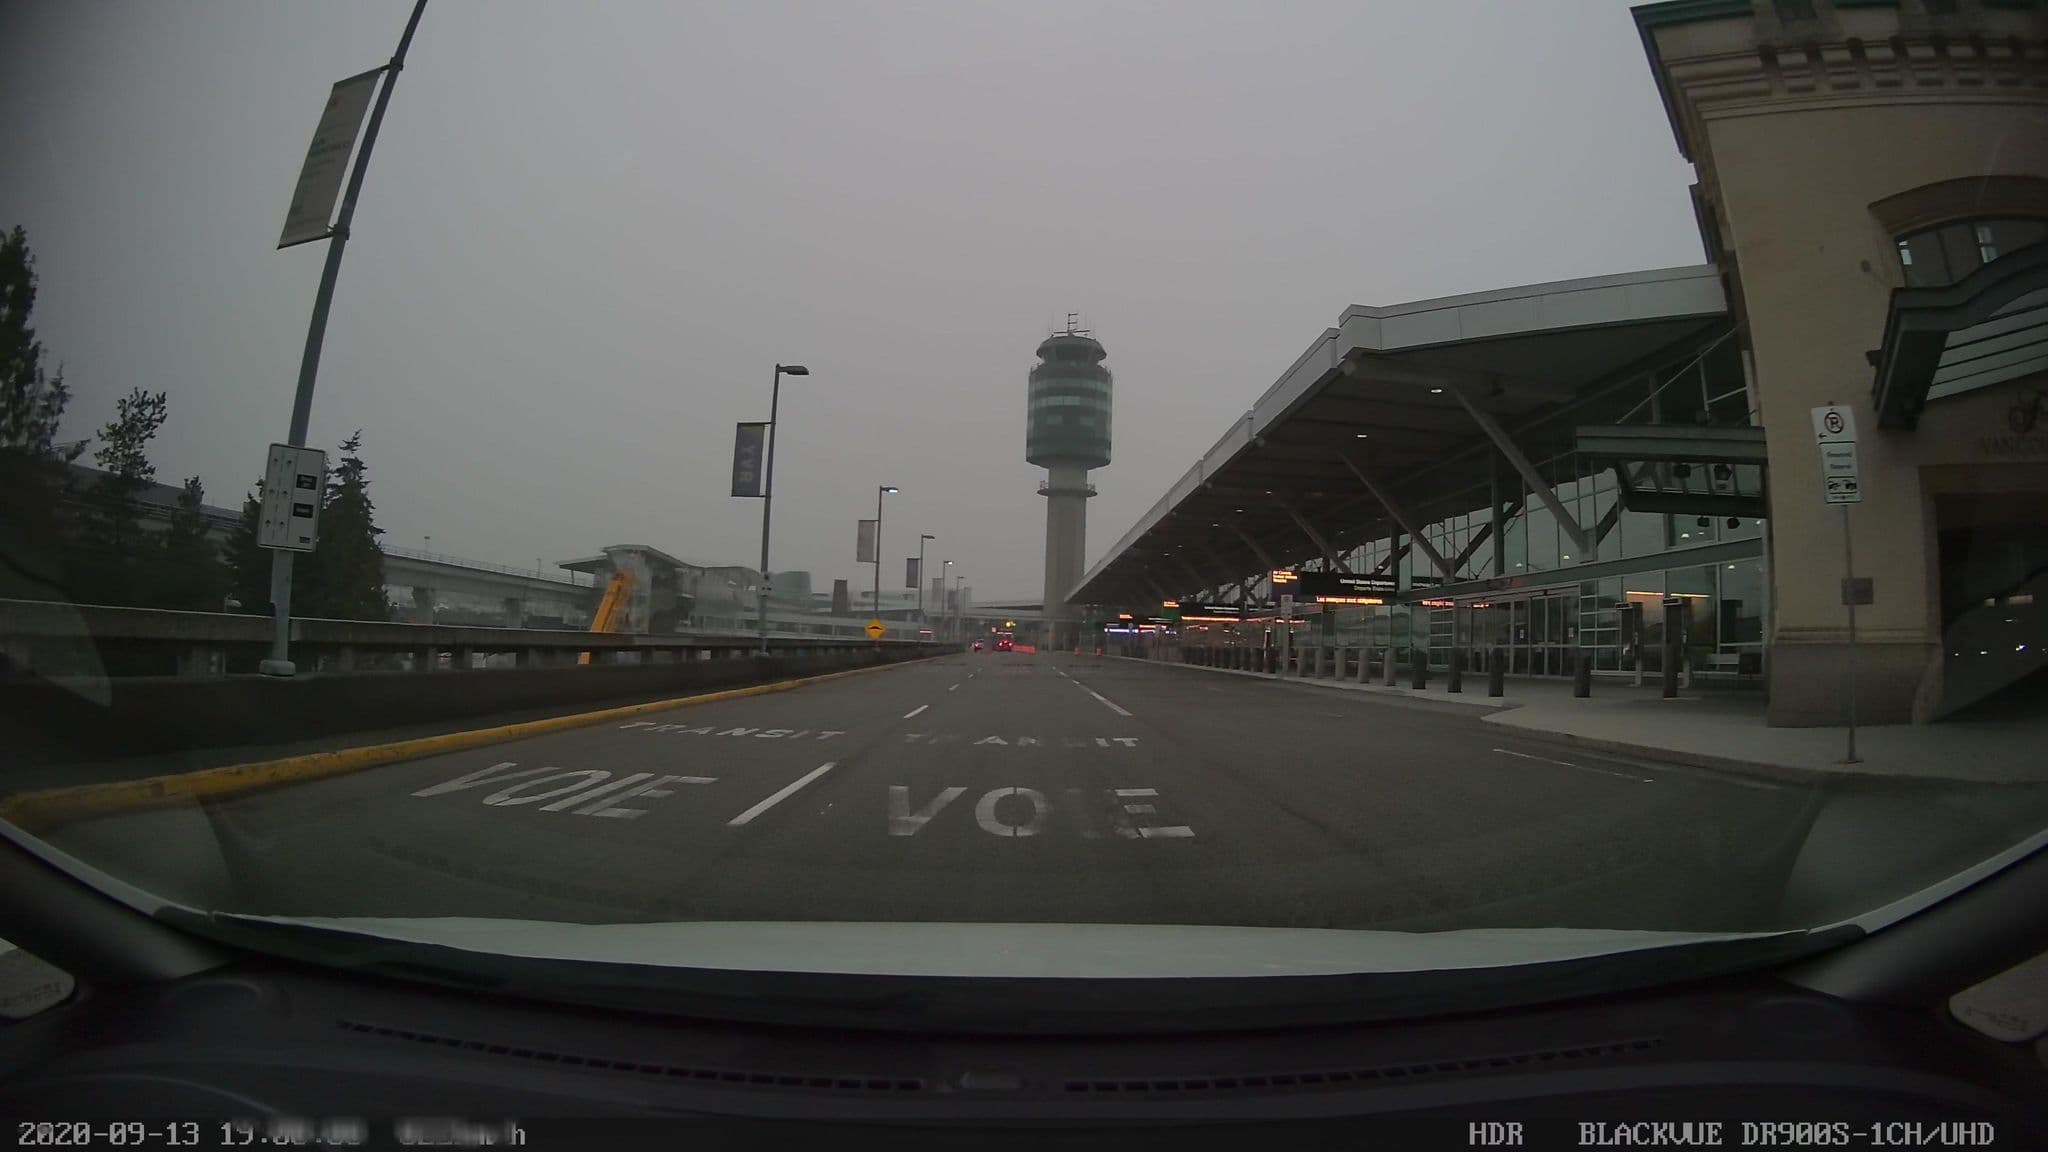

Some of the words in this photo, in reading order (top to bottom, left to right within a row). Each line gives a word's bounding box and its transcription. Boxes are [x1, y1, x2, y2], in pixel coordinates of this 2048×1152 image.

[619, 721, 846, 740] TRANSIT
[409, 761, 719, 818] VOIE
[888, 785, 1196, 838] VOE
